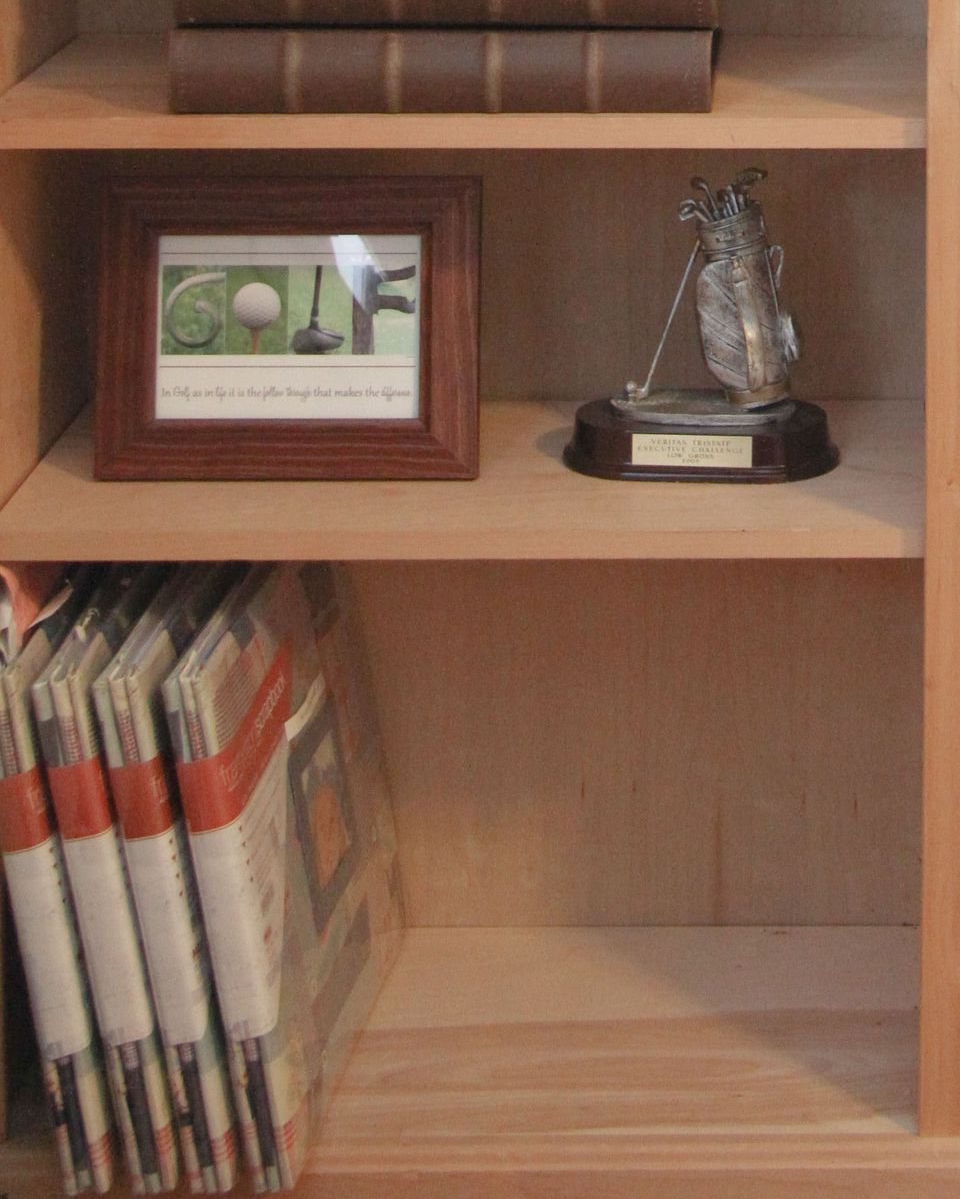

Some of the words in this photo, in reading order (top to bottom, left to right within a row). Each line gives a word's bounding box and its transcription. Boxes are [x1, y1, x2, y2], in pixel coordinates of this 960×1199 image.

[313, 386, 332, 397] that
[334, 386, 363, 397] makes
[365, 386, 380, 397] the
